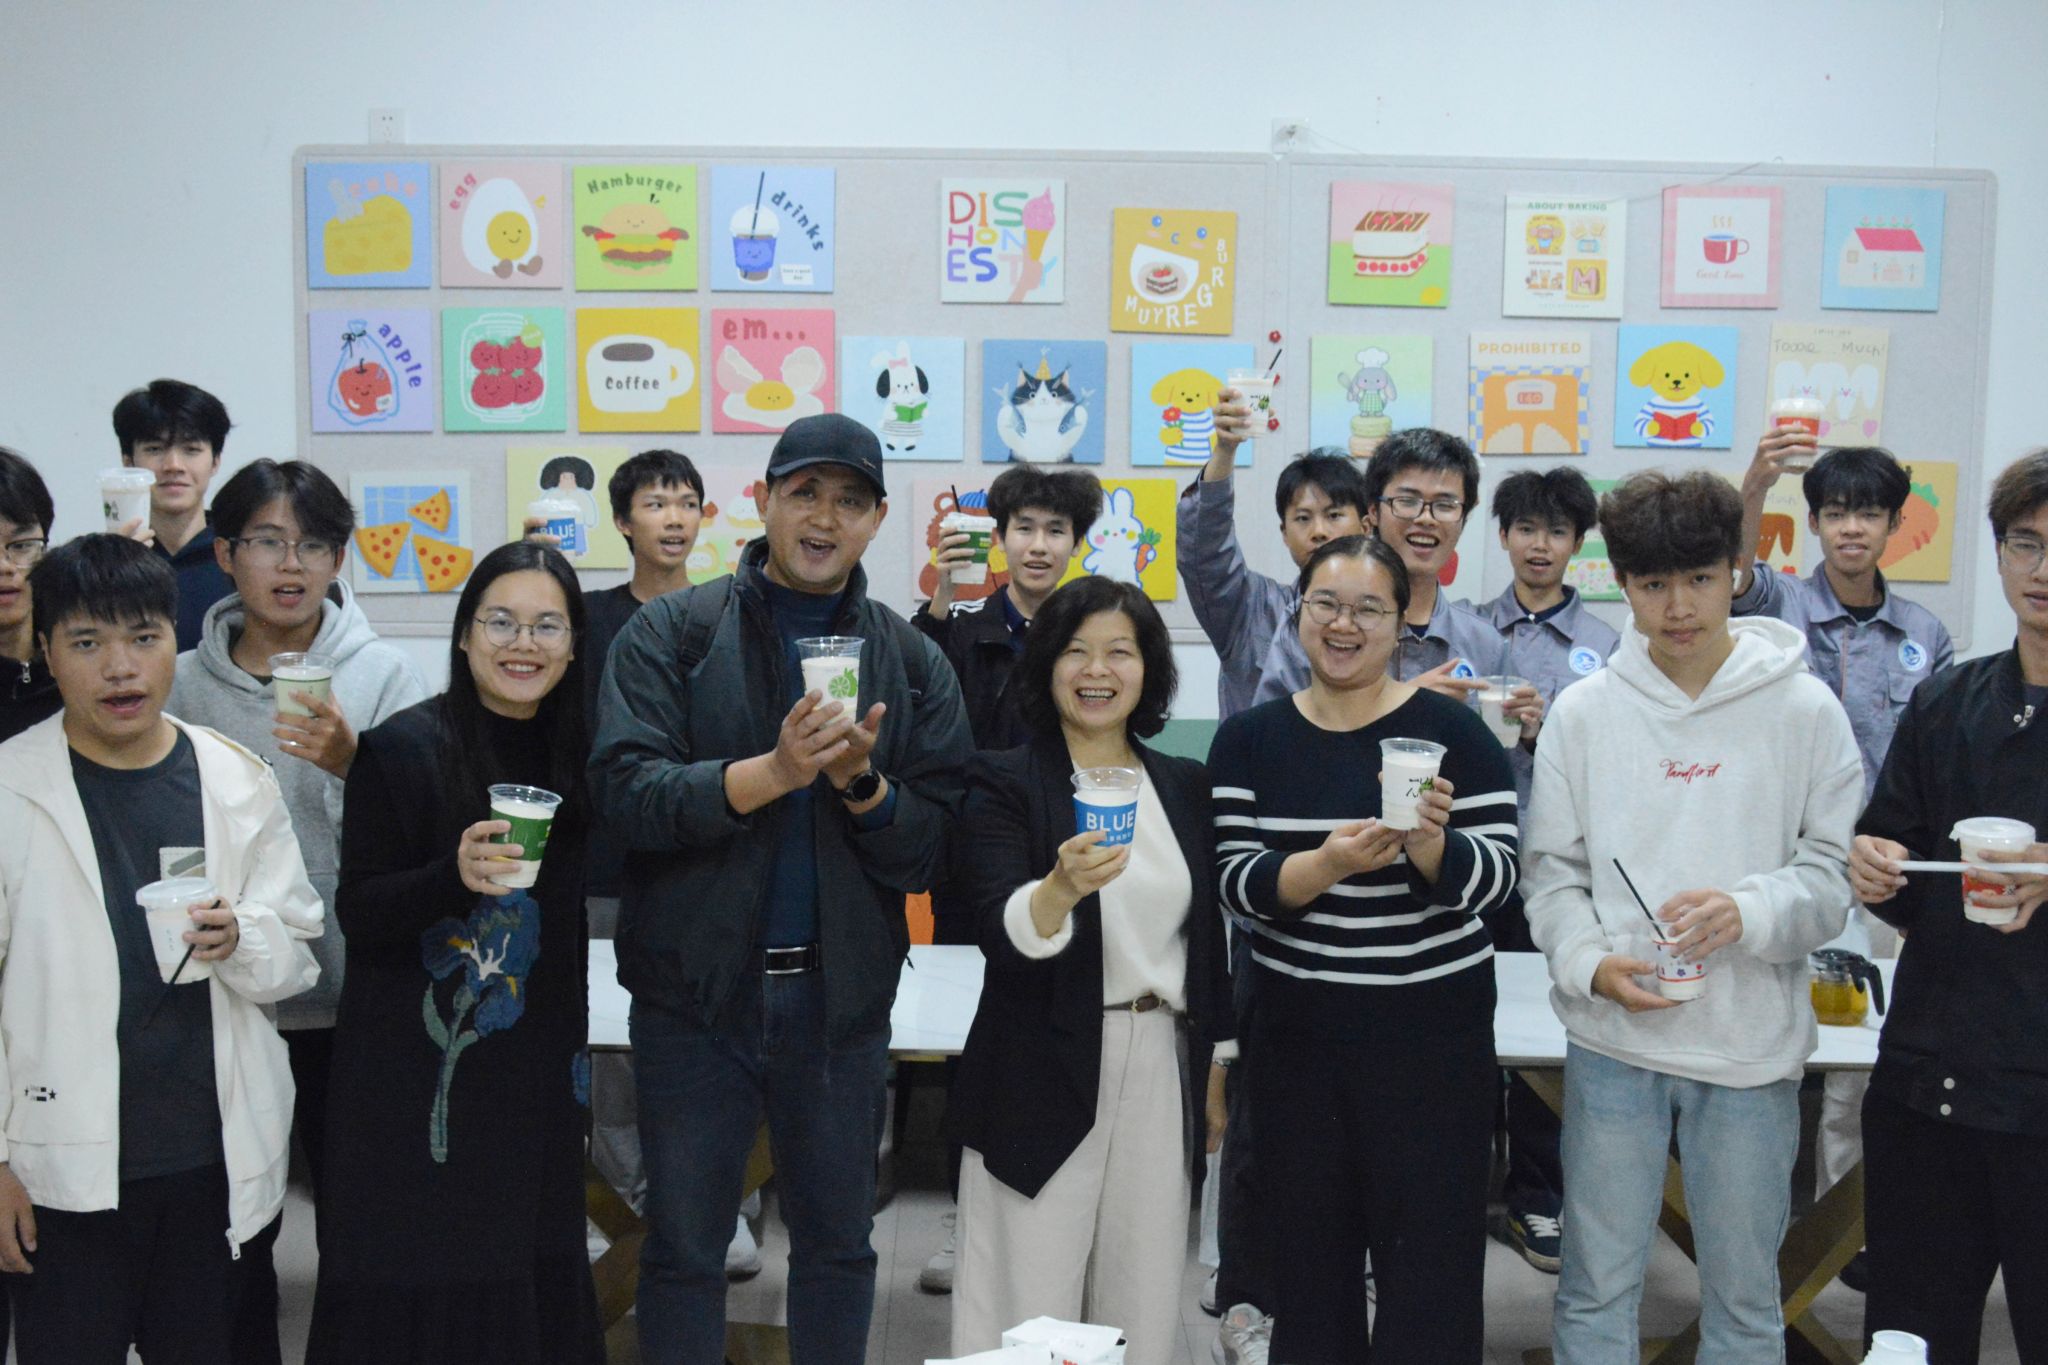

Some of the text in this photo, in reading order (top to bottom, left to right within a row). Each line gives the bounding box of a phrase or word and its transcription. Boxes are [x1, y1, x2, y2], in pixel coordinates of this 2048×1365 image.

[449, 173, 477, 210] egg
[587, 172, 682, 194] Hamburger
[949, 191, 1029, 227] DIS
[1526, 202, 1607, 211] ABOUT BAKING
[771, 191, 824, 251] drinks
[378, 323, 422, 388] apple
[1478, 342, 1582, 354] PROHIBITED
[605, 376, 660, 390] Coffee
[1086, 810, 1135, 832] BLUE
